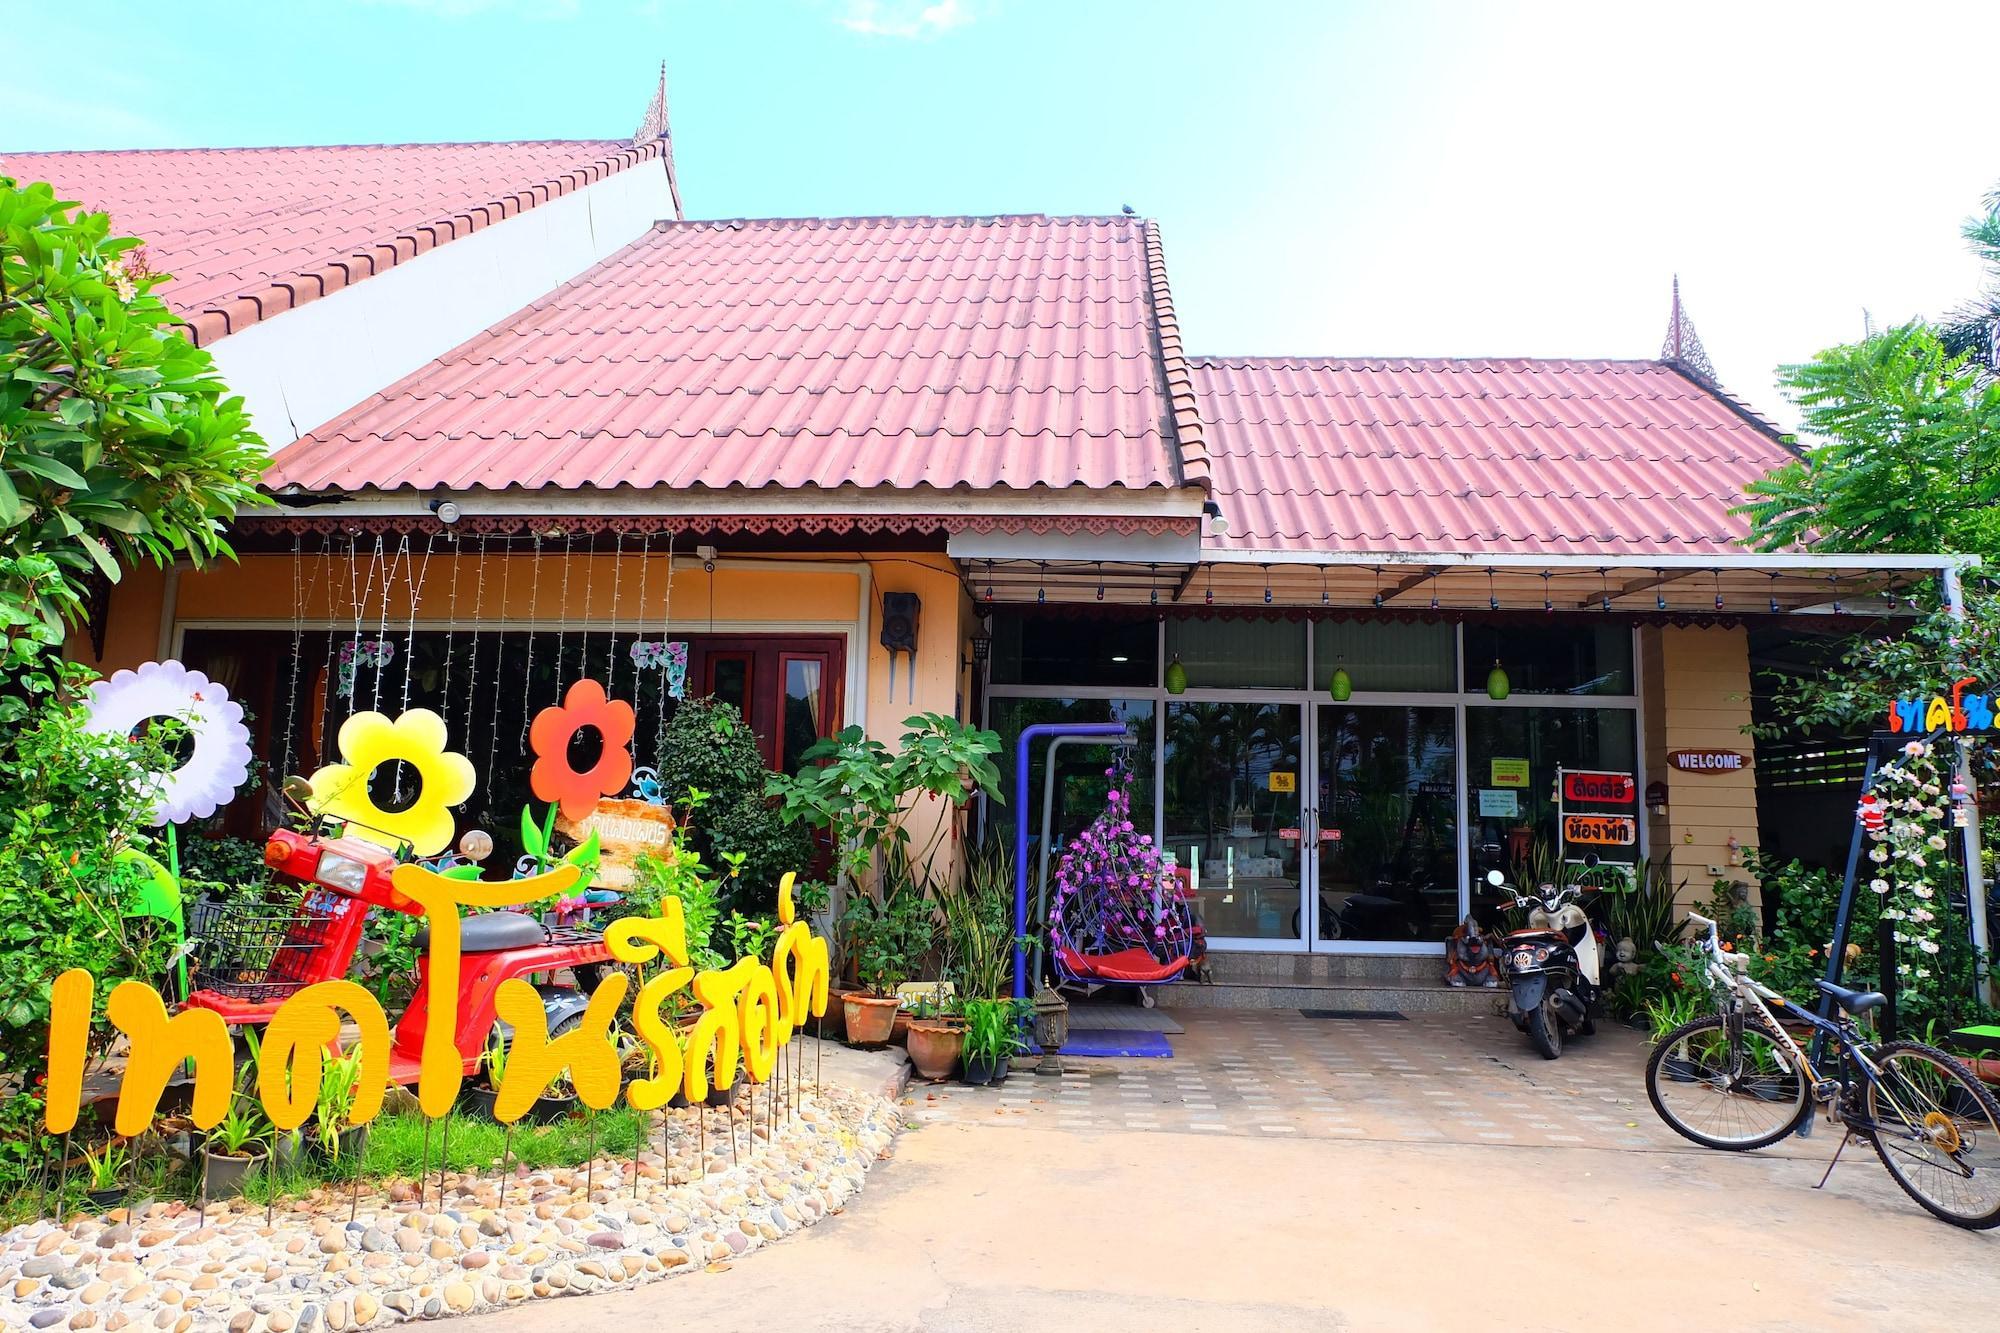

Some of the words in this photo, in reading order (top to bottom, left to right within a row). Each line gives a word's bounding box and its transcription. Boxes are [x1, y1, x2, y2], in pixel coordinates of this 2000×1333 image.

[1678, 753, 1742, 769] WELCOME
[1573, 777, 1625, 799] ติดต่อ
[1568, 817, 1629, 842] ห้องพัก
[46, 871, 830, 1137] เทคโนรีสอร์ท
[1751, 1003, 1798, 1058] MERIDA
